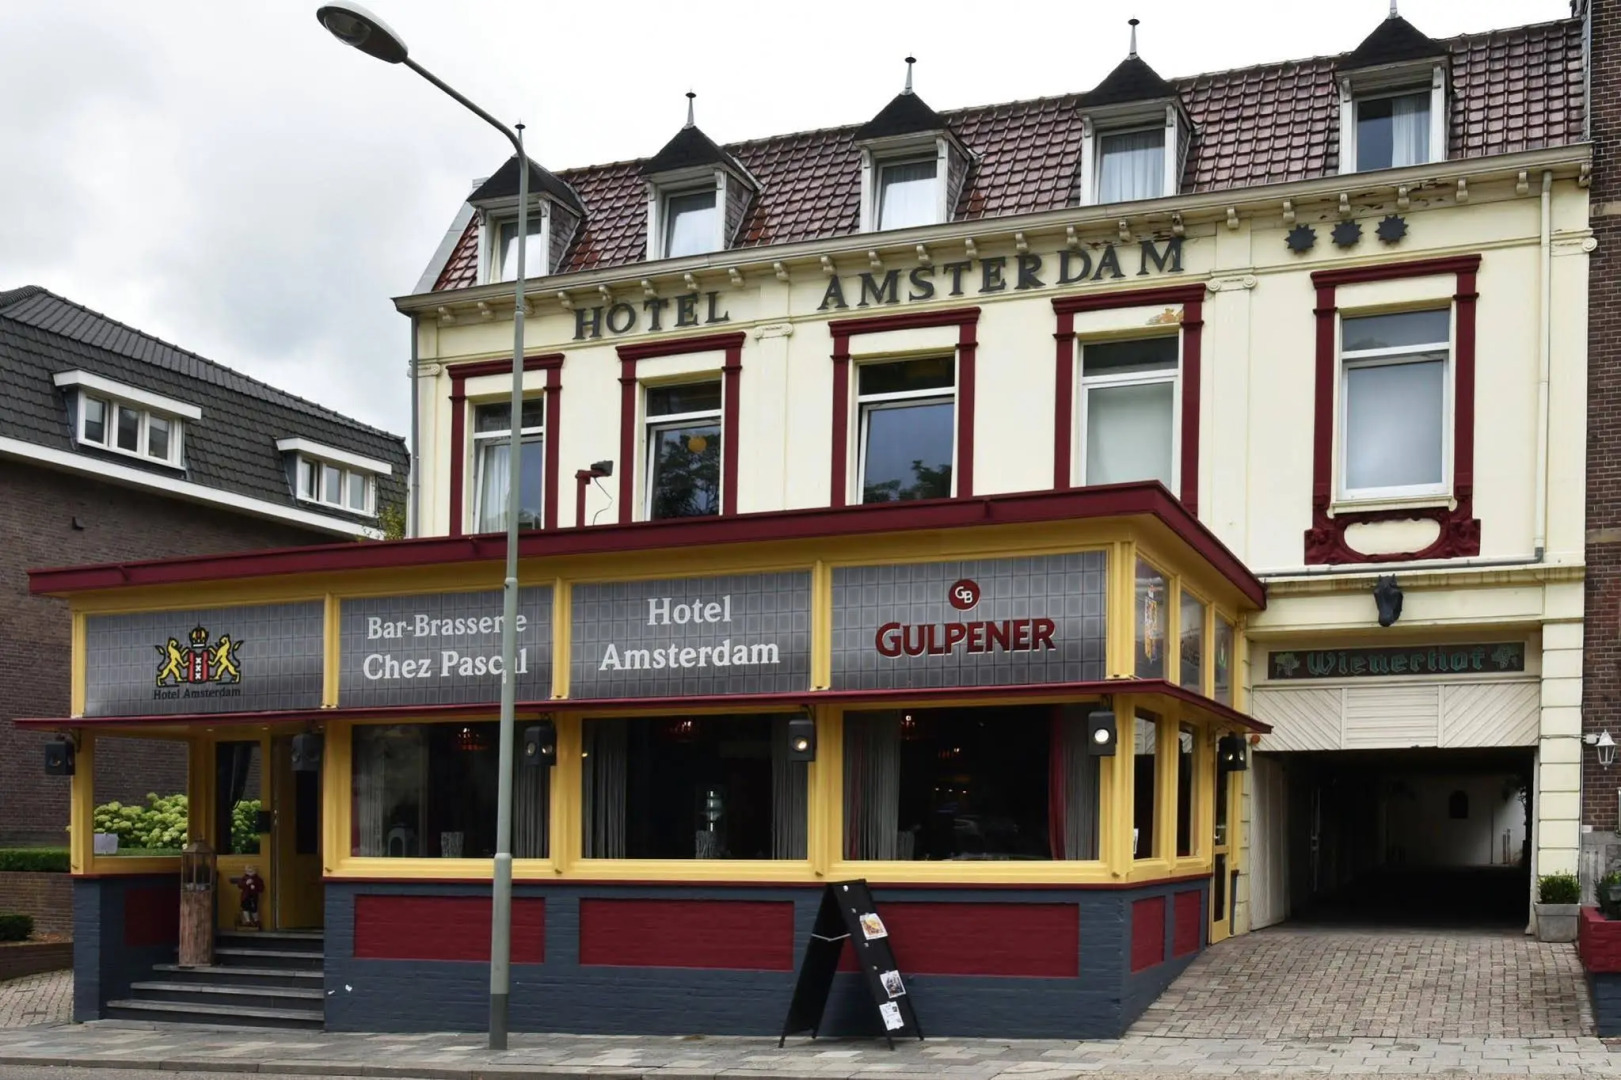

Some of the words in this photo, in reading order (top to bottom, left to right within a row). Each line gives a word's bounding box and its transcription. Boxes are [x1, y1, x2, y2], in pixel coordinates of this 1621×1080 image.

[572, 291, 730, 340] HOTEL
[817, 237, 1185, 310] AMSTERDAM
[647, 595, 732, 626] Hotel
[367, 614, 527, 640] Bar-Brassere
[875, 618, 1056, 659] GULPENER
[363, 653, 432, 680] Chez
[440, 648, 528, 677] Pascl
[599, 639, 781, 671] Amsterdam
[153, 688, 180, 700] Hotel
[183, 686, 241, 699] Amsterdam
